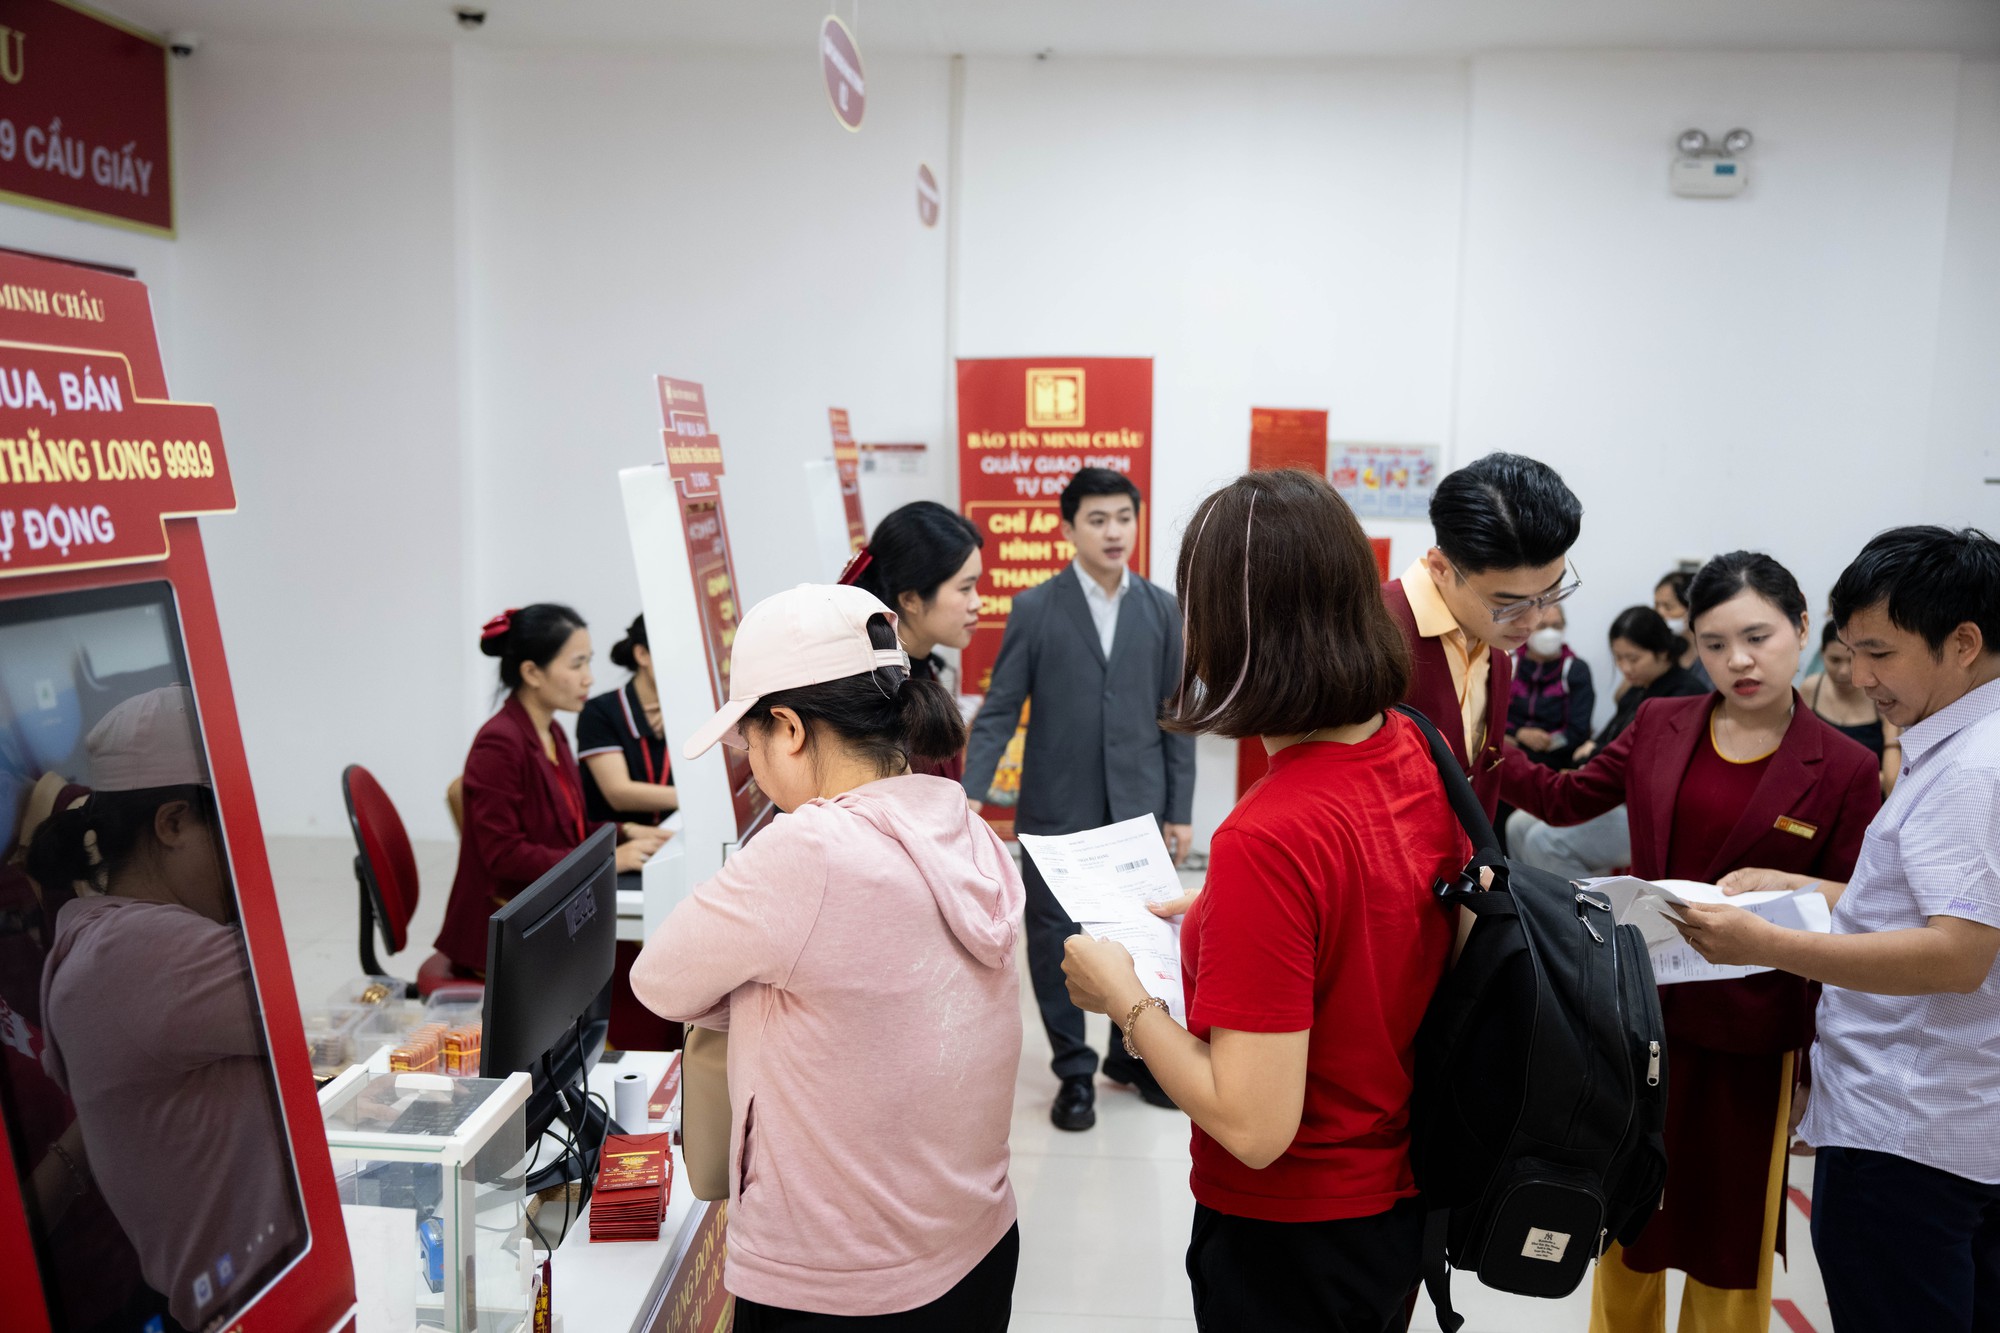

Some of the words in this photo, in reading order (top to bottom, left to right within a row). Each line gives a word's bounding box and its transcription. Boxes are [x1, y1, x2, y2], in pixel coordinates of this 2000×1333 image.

[24, 116, 85, 180] CẦU
[91, 141, 152, 197] GIẤY
[52, 289, 105, 323] CHÂU
[59, 365, 123, 412] BÁN
[1041, 431, 1091, 449] MINH
[91, 438, 162, 481] LONG
[163, 439, 214, 479] 999.9
[1034, 455, 1082, 474] GIAO
[22, 504, 115, 557] ĐỘNG
[1029, 509, 1060, 534] ÁP
[999, 536, 1052, 561] HÌNH
